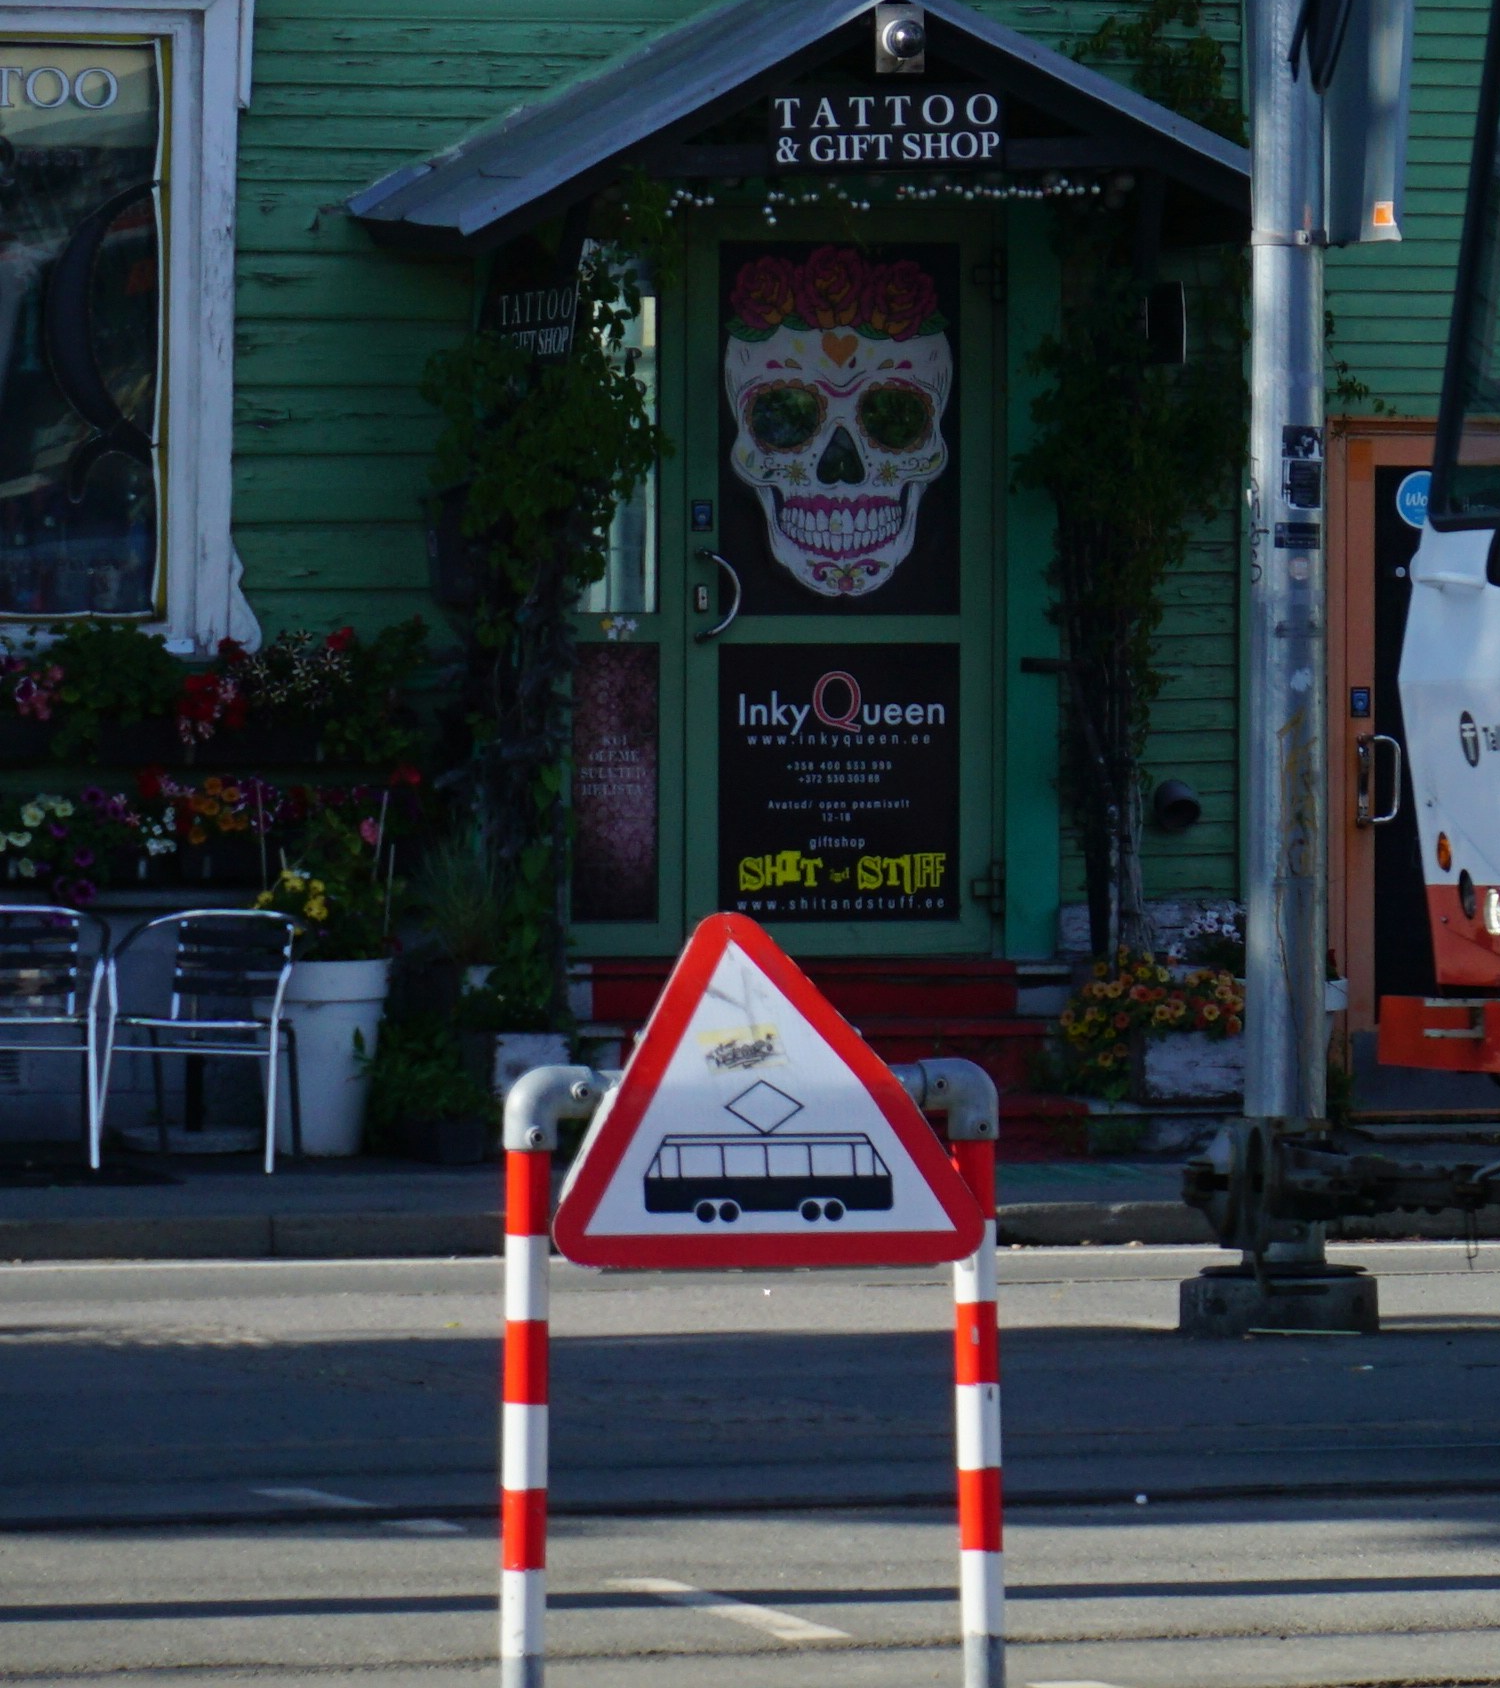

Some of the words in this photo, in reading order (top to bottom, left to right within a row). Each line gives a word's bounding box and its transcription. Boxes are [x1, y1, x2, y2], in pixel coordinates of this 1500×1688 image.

[774, 93, 999, 130] TATTOO
[775, 136, 800, 164] &
[809, 132, 894, 162] GIFT
[902, 130, 1000, 161] SHOP
[500, 287, 573, 326] TATTOO
[537, 325, 570, 356] SHOP
[747, 732, 931, 748] www.inkyqueen.ee
[798, 773, 823, 785] +372
[819, 800, 847, 811] open
[852, 798, 910, 812] peamiselt
[809, 835, 866, 850] giftshop
[738, 850, 823, 892] SHIT
[857, 852, 946, 895] STUFF
[736, 894, 945, 911] www.shitandstuff.ee
